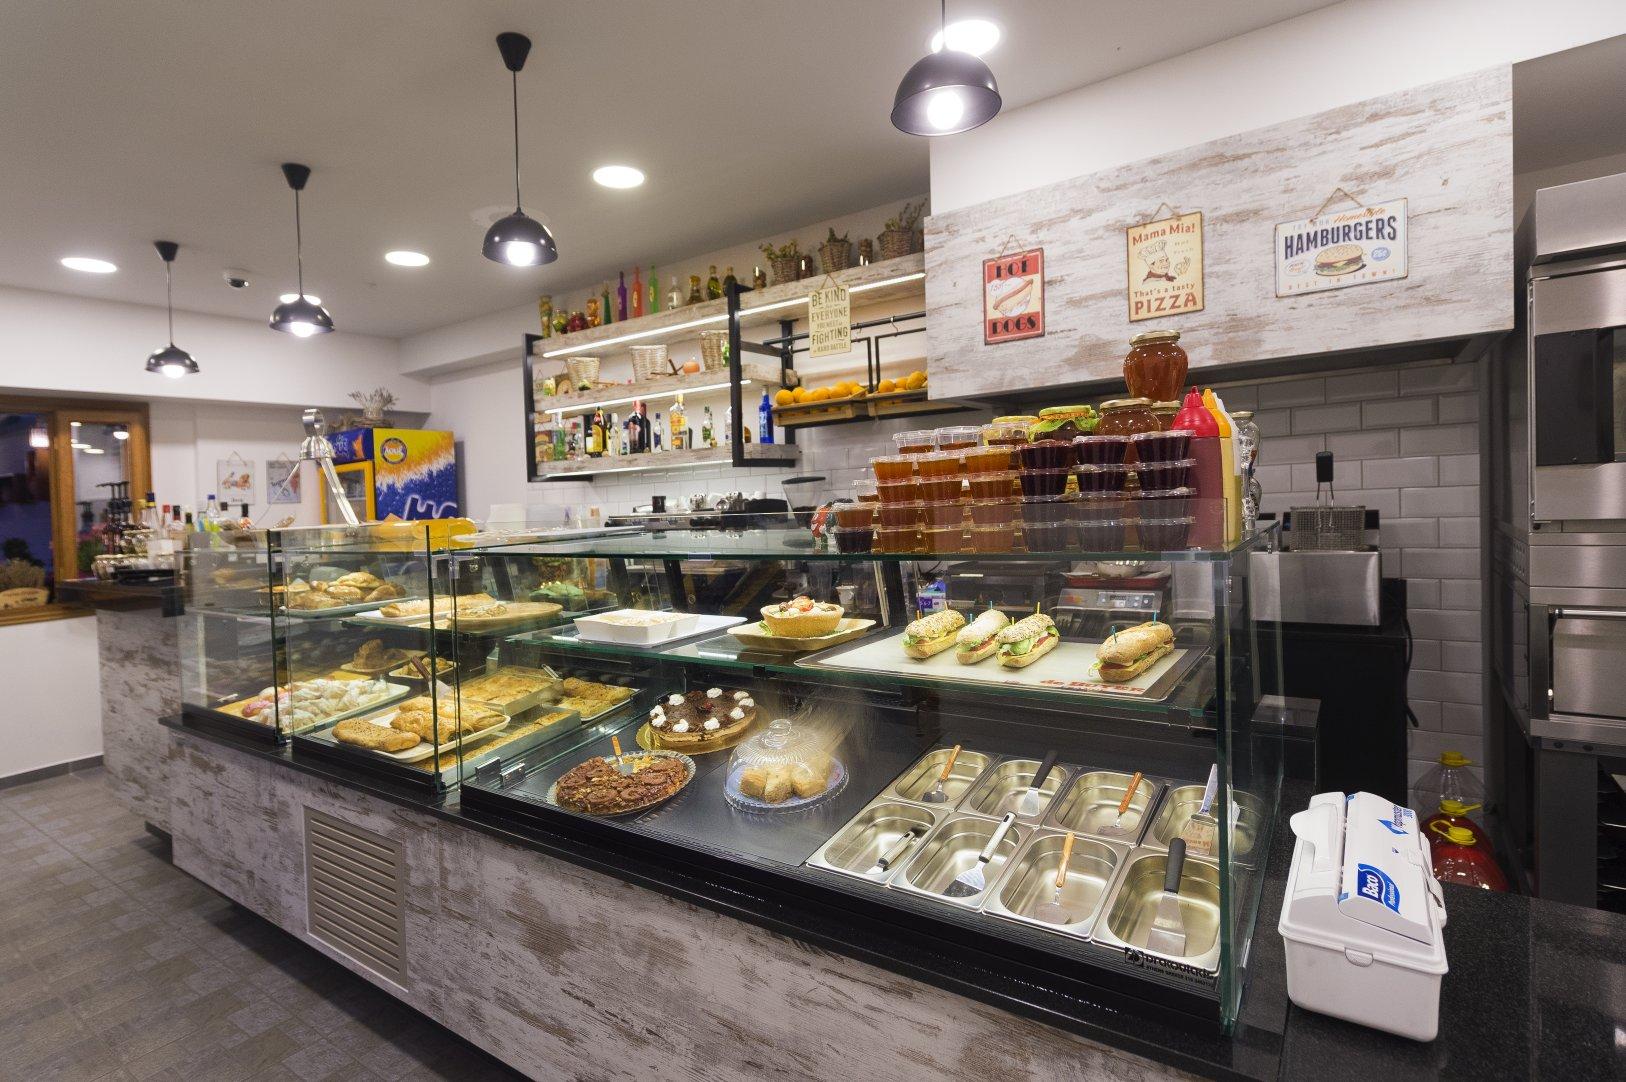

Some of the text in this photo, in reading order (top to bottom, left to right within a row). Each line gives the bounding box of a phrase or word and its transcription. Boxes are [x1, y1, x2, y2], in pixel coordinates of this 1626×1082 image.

[1132, 228, 1166, 246] Mama
[1169, 223, 1195, 235] Mia!
[1284, 216, 1397, 260] HAMBURGERS
[996, 259, 1029, 279] HOT
[812, 293, 822, 307] BE
[825, 288, 846, 303] KIND
[1134, 288, 1160, 298] That's
[1172, 283, 1195, 292] tasty
[1135, 292, 1197, 315] PIZZA
[811, 307, 847, 322] EVERYONE
[992, 316, 1036, 334] DOGS
[812, 327, 848, 345] FIGHTING
[1362, 875, 1379, 899] Baco
